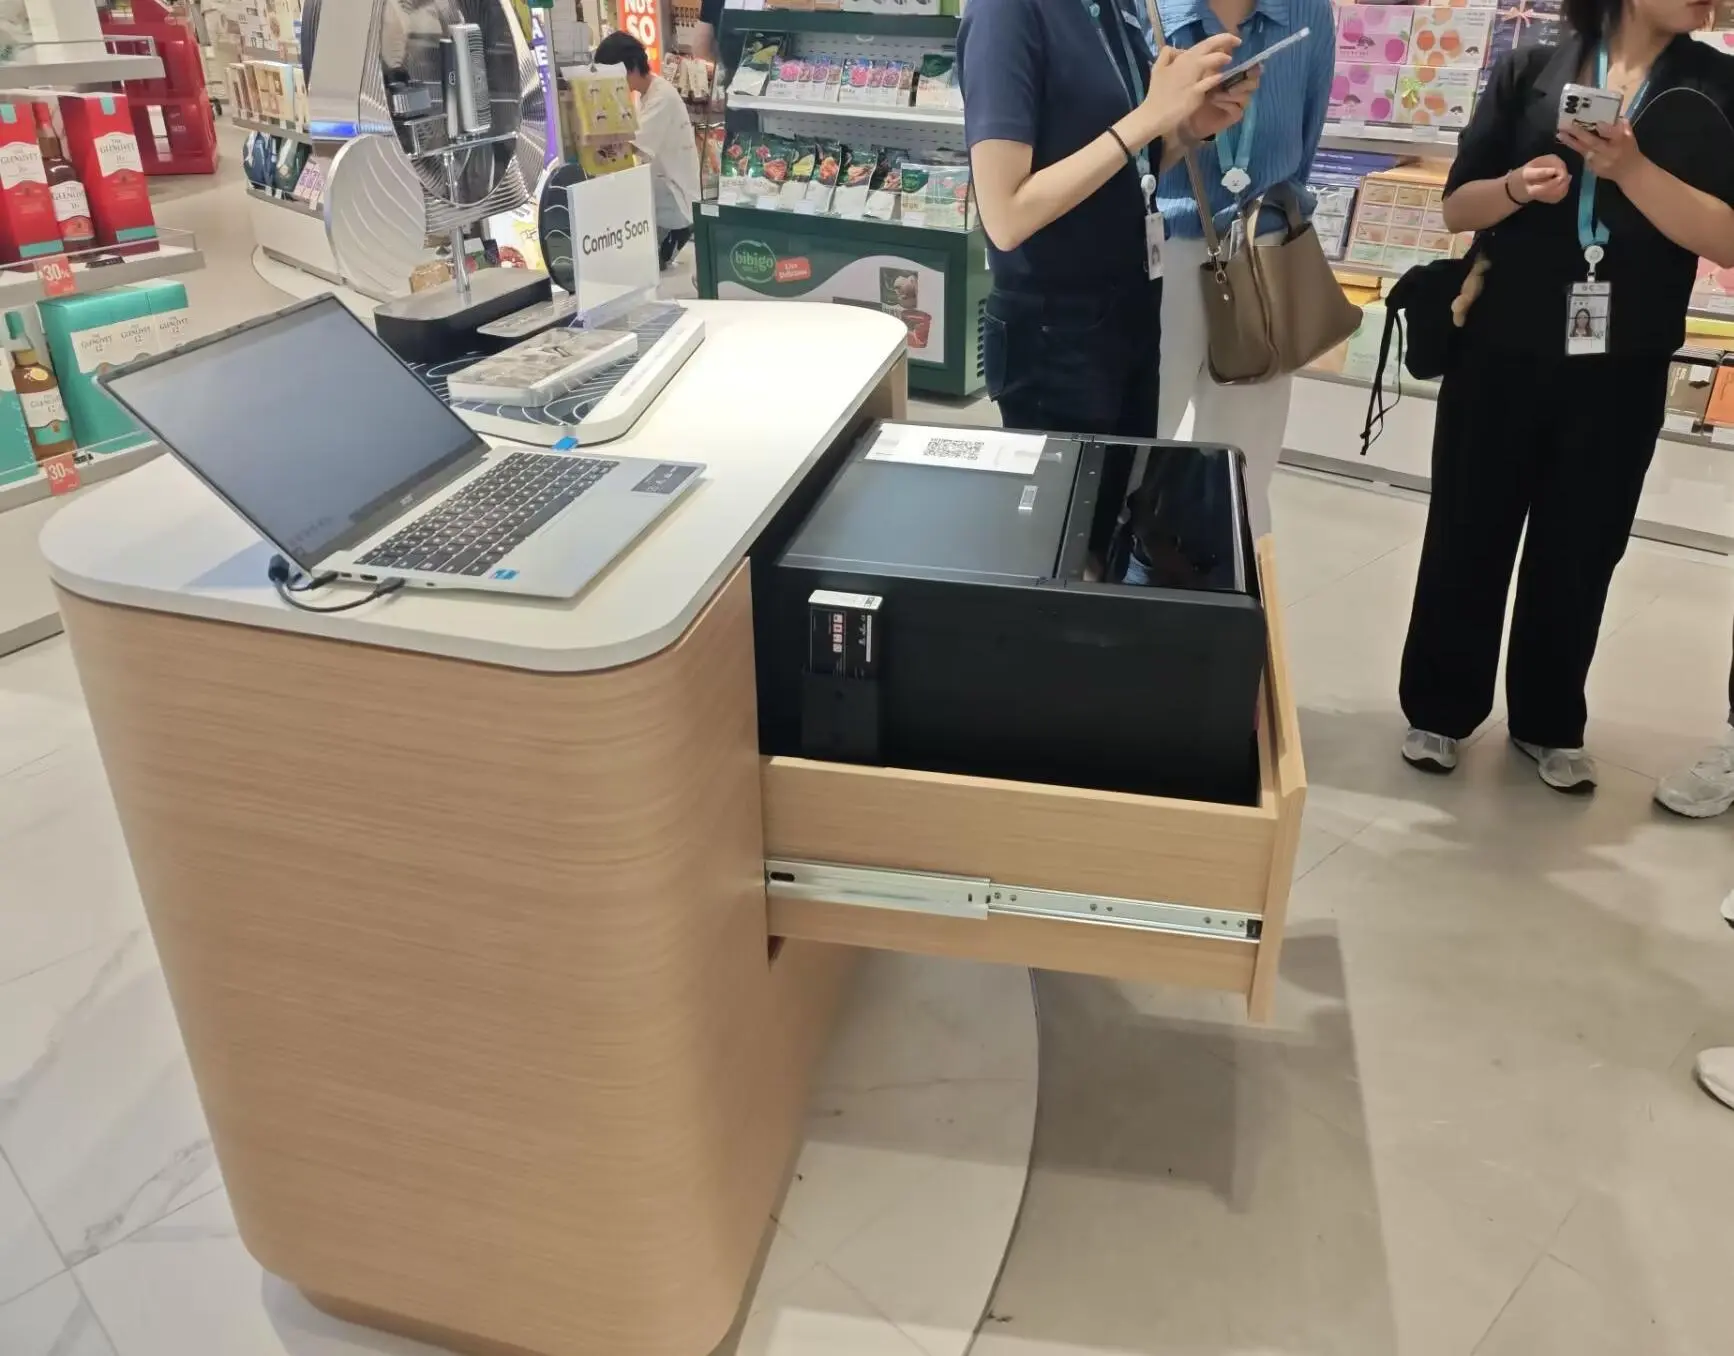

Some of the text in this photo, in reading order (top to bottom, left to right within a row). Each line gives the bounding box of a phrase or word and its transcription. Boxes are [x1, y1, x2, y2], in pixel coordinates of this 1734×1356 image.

[583, 220, 649, 255] Coming Soon
[735, 251, 773, 272] bibigo
